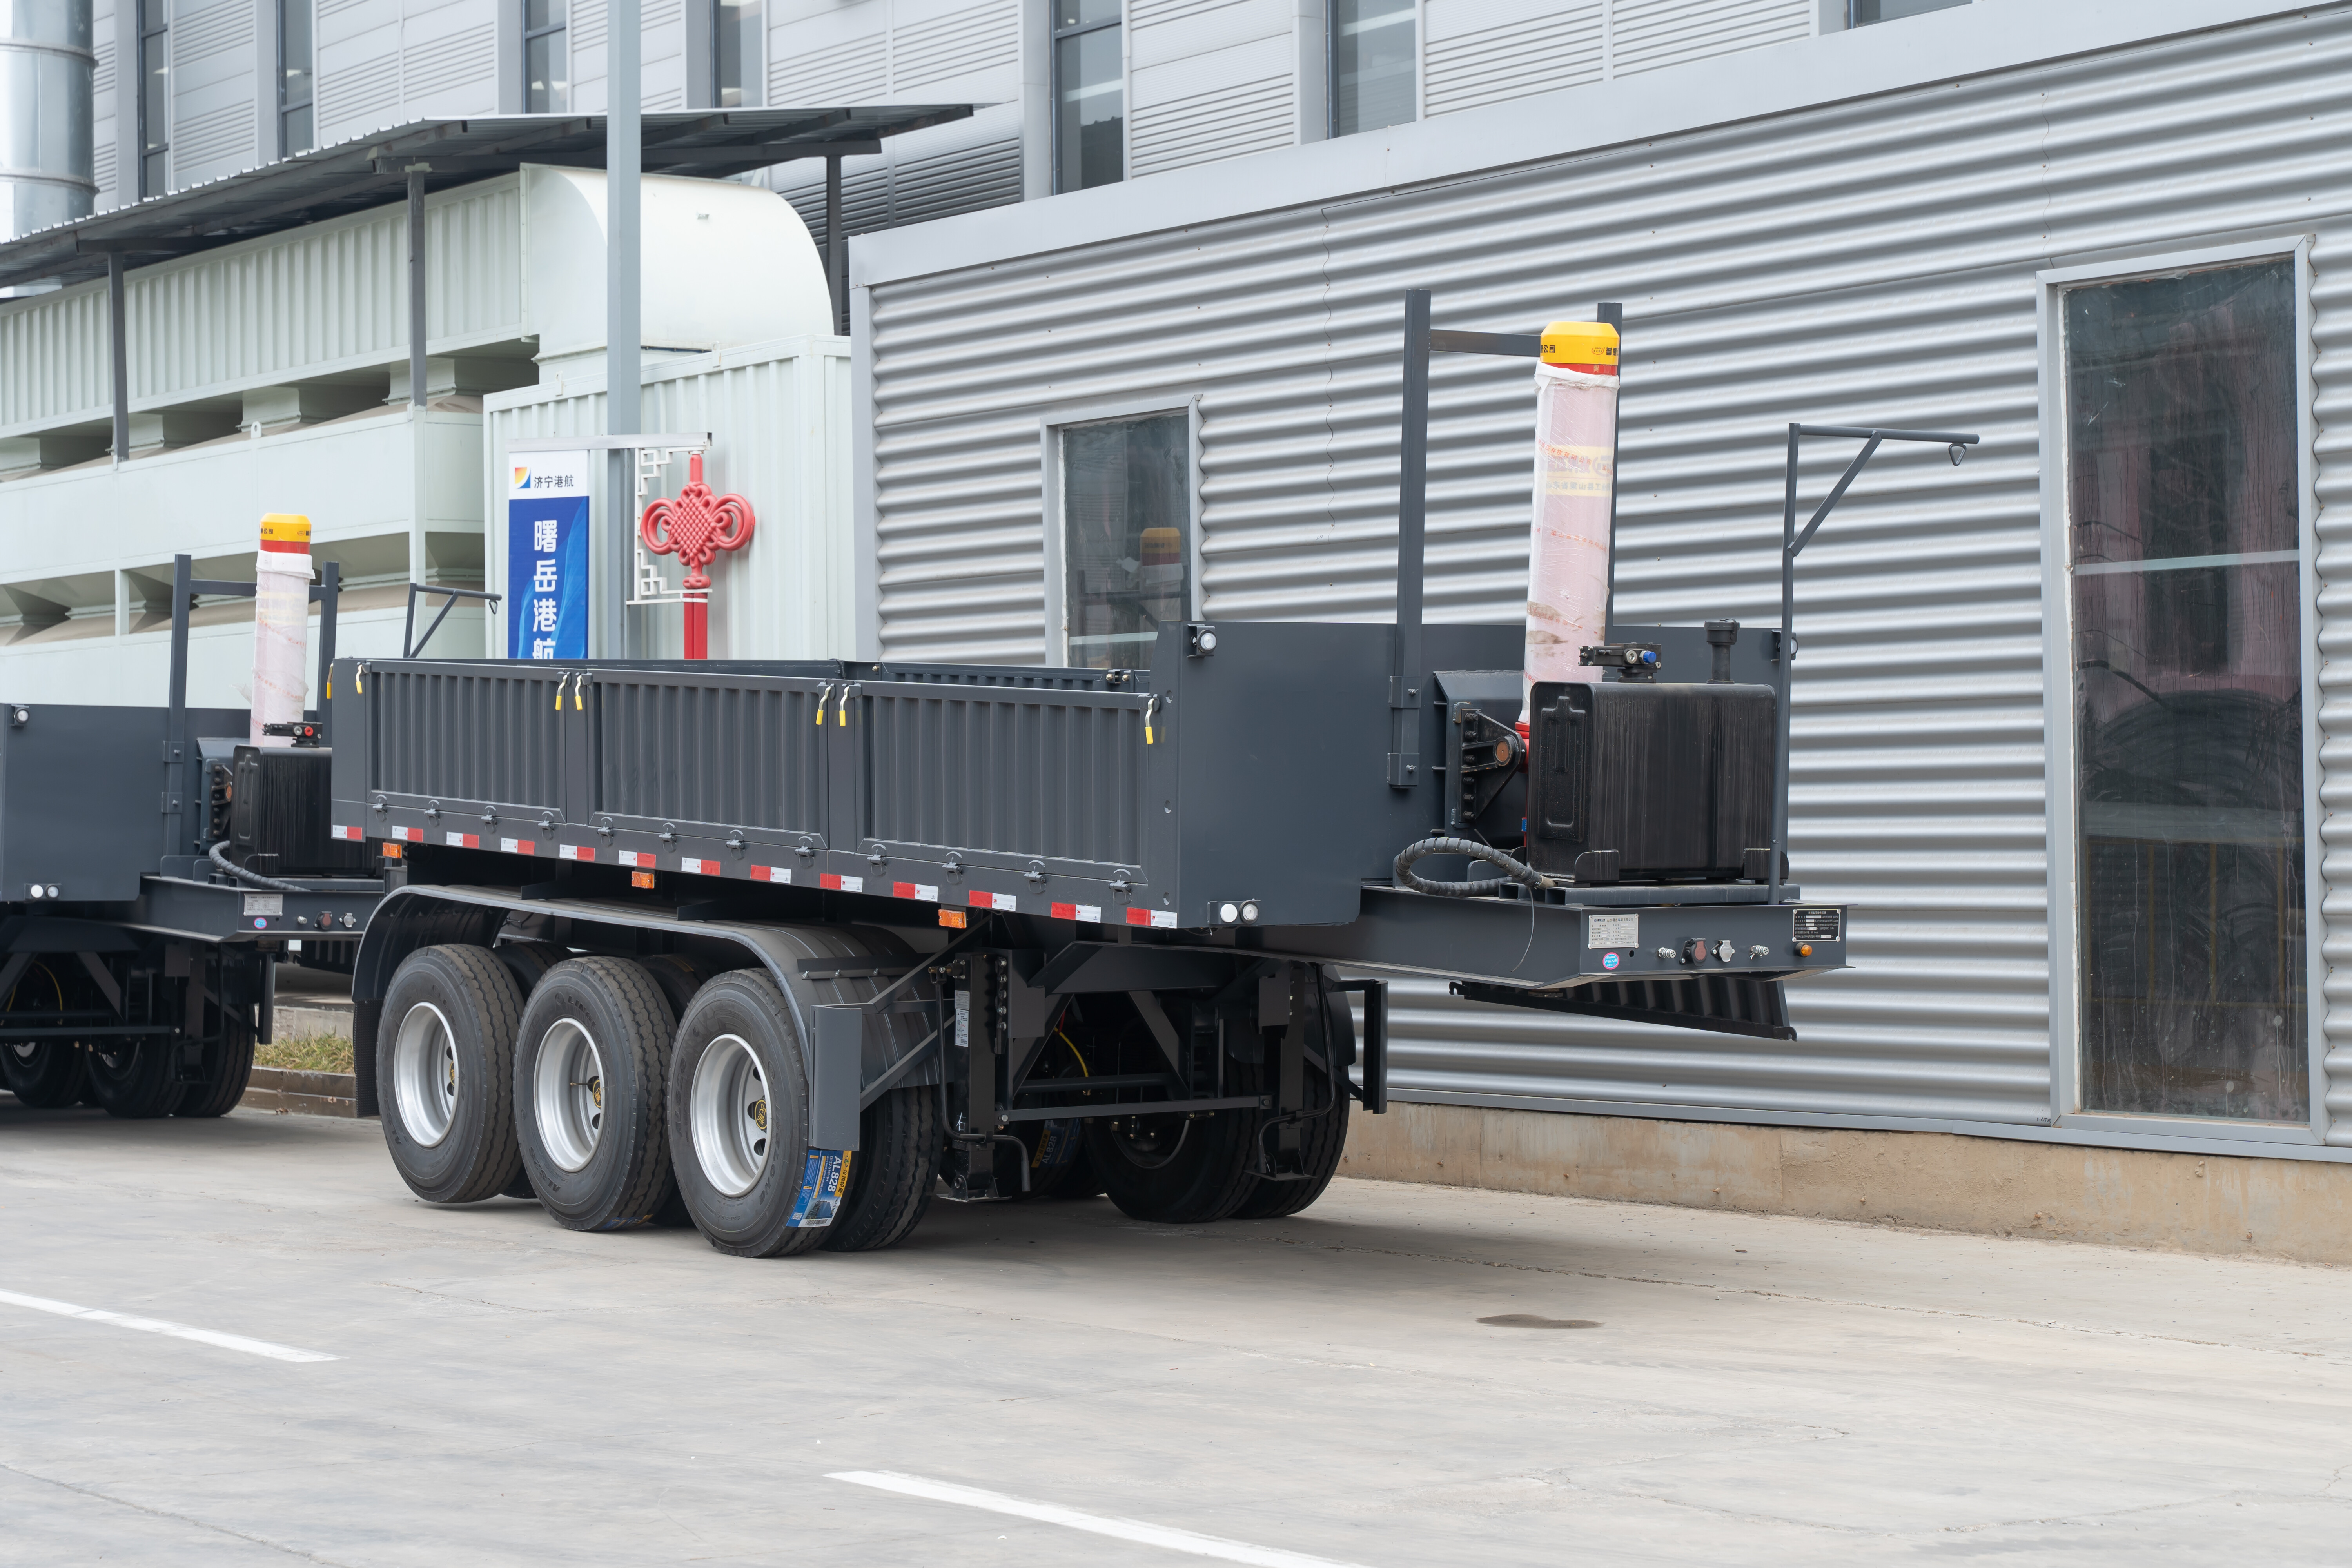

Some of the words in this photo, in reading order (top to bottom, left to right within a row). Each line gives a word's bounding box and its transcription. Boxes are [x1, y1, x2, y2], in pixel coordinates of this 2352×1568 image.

[534, 474, 574, 489] 济宁港航
[532, 520, 558, 659] 曙岳港航
[1042, 1135, 1058, 1164] AL828
[827, 1155, 842, 1192] AL828
